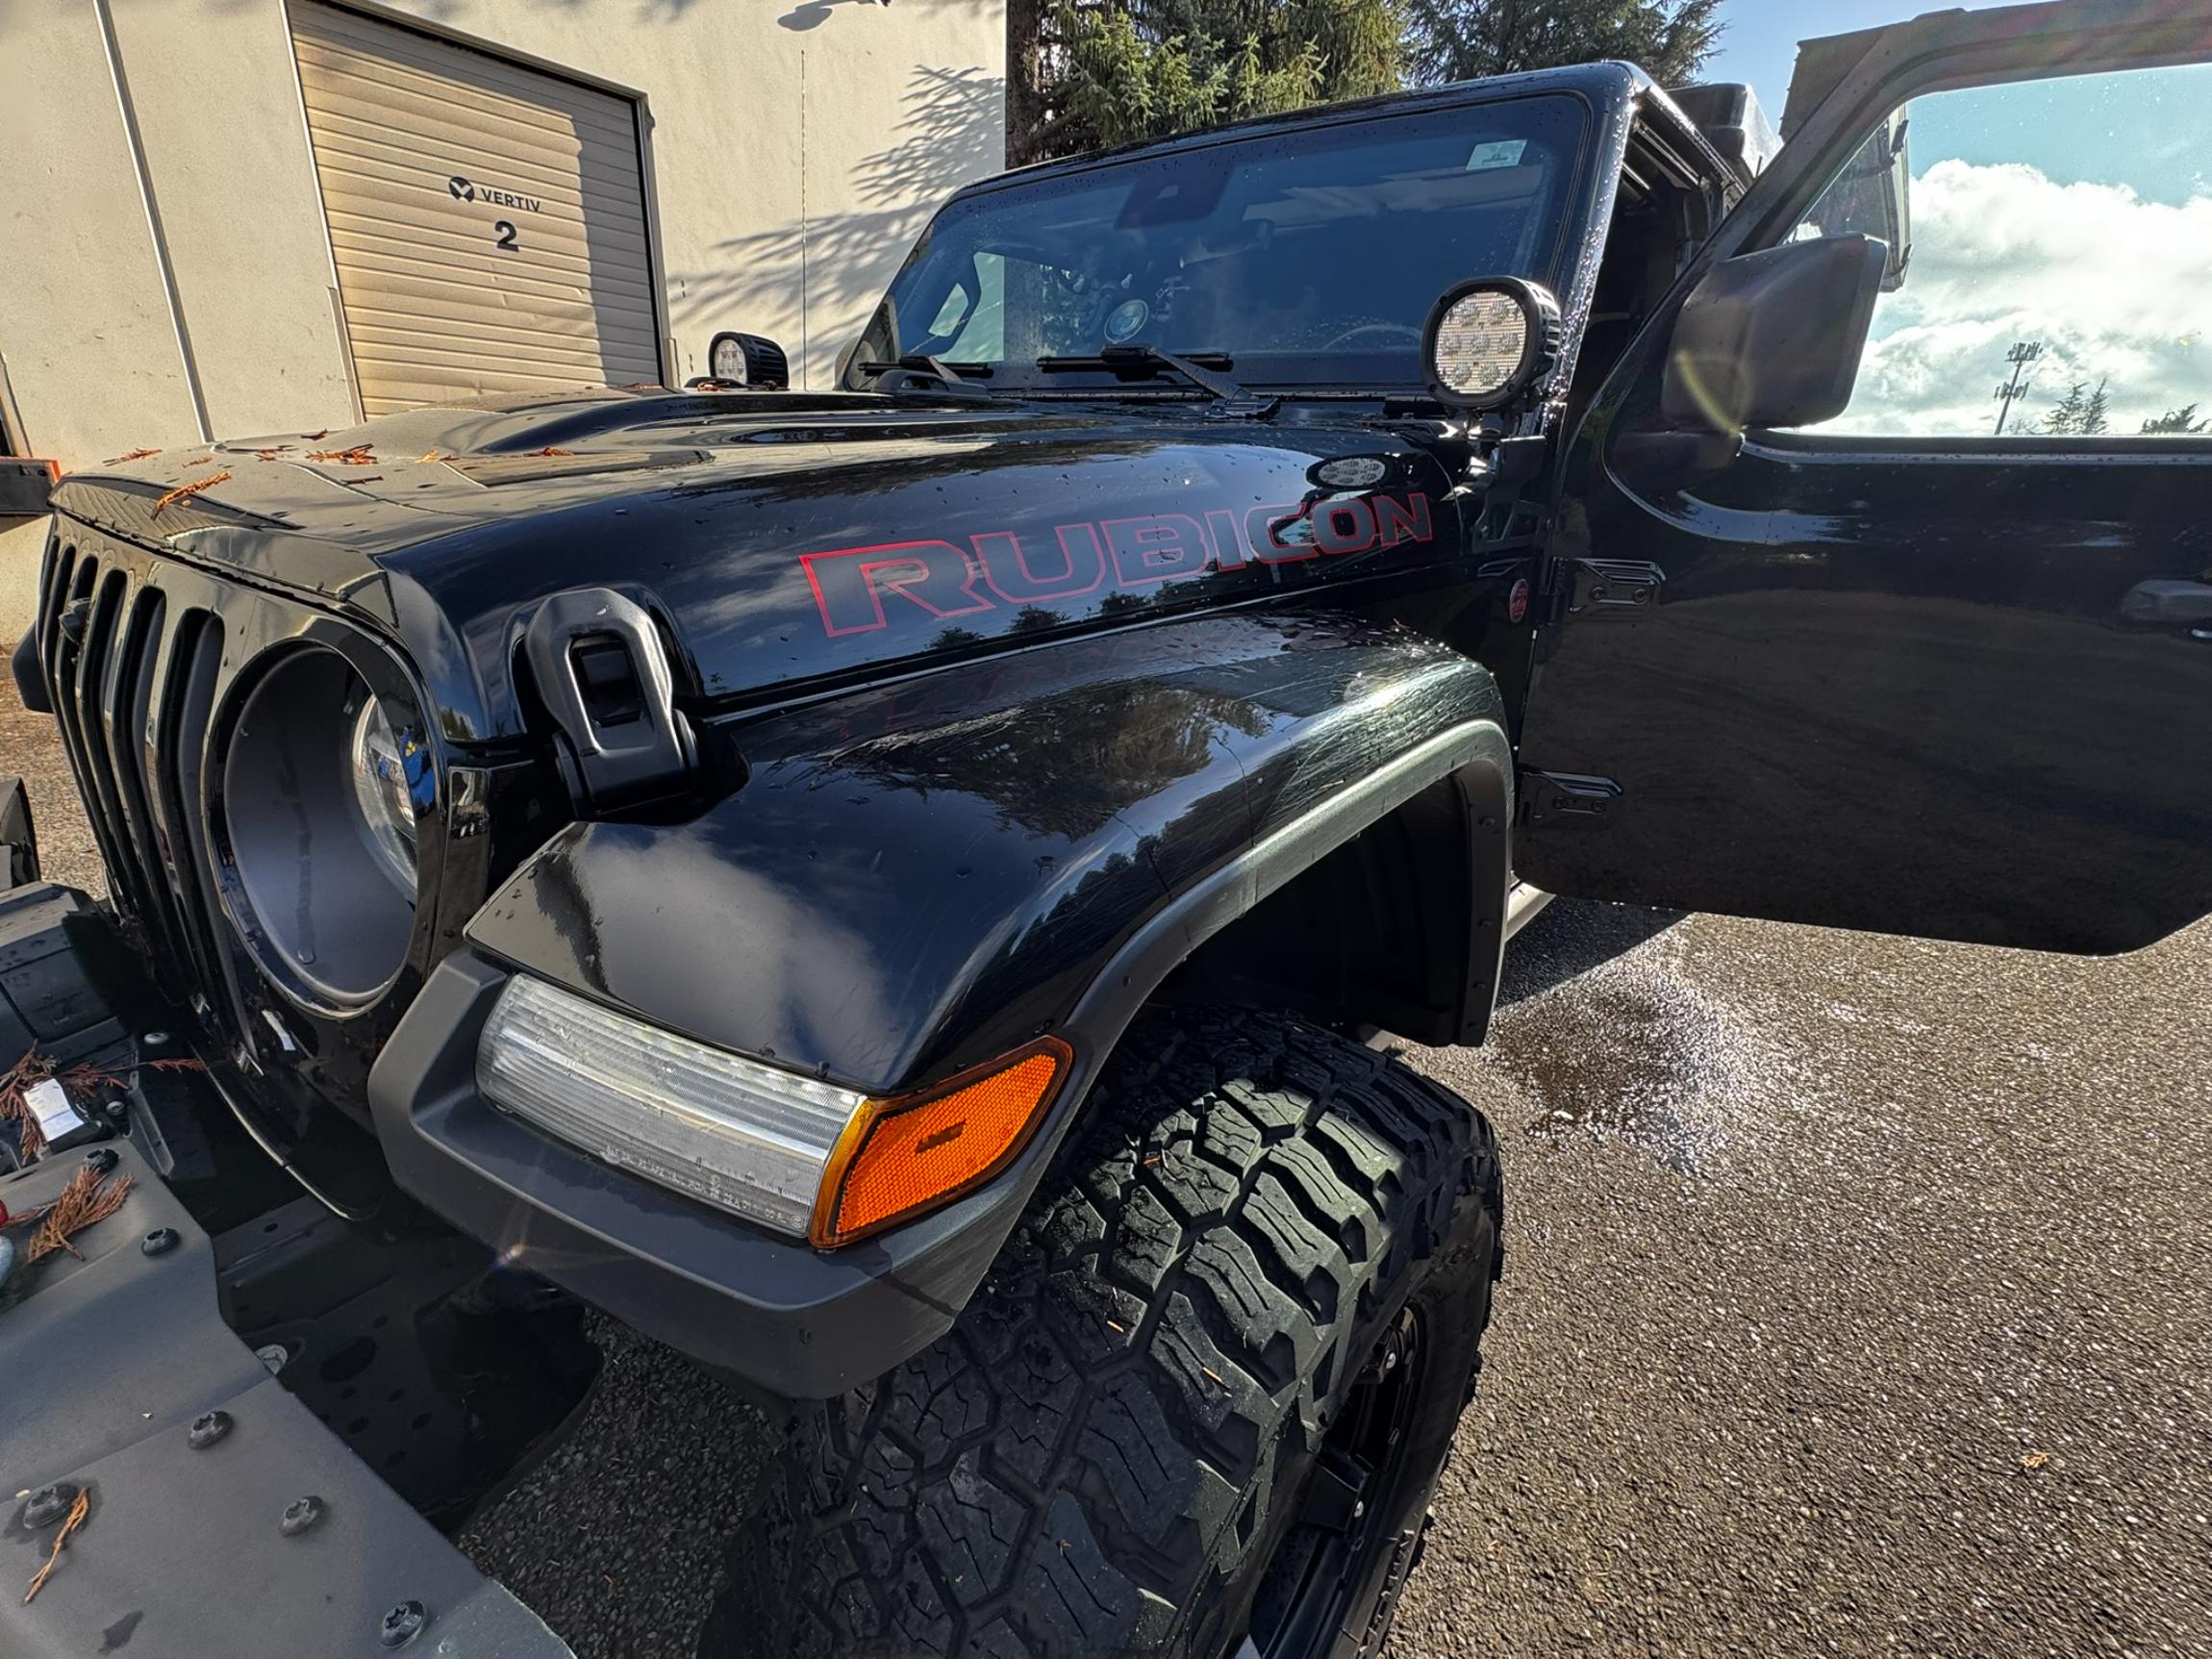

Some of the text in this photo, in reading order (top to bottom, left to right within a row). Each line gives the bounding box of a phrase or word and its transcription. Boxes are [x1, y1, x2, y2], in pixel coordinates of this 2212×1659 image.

[481, 189, 540, 212] VERTIV
[494, 220, 519, 252] 2
[798, 492, 1433, 638] RUBICON
